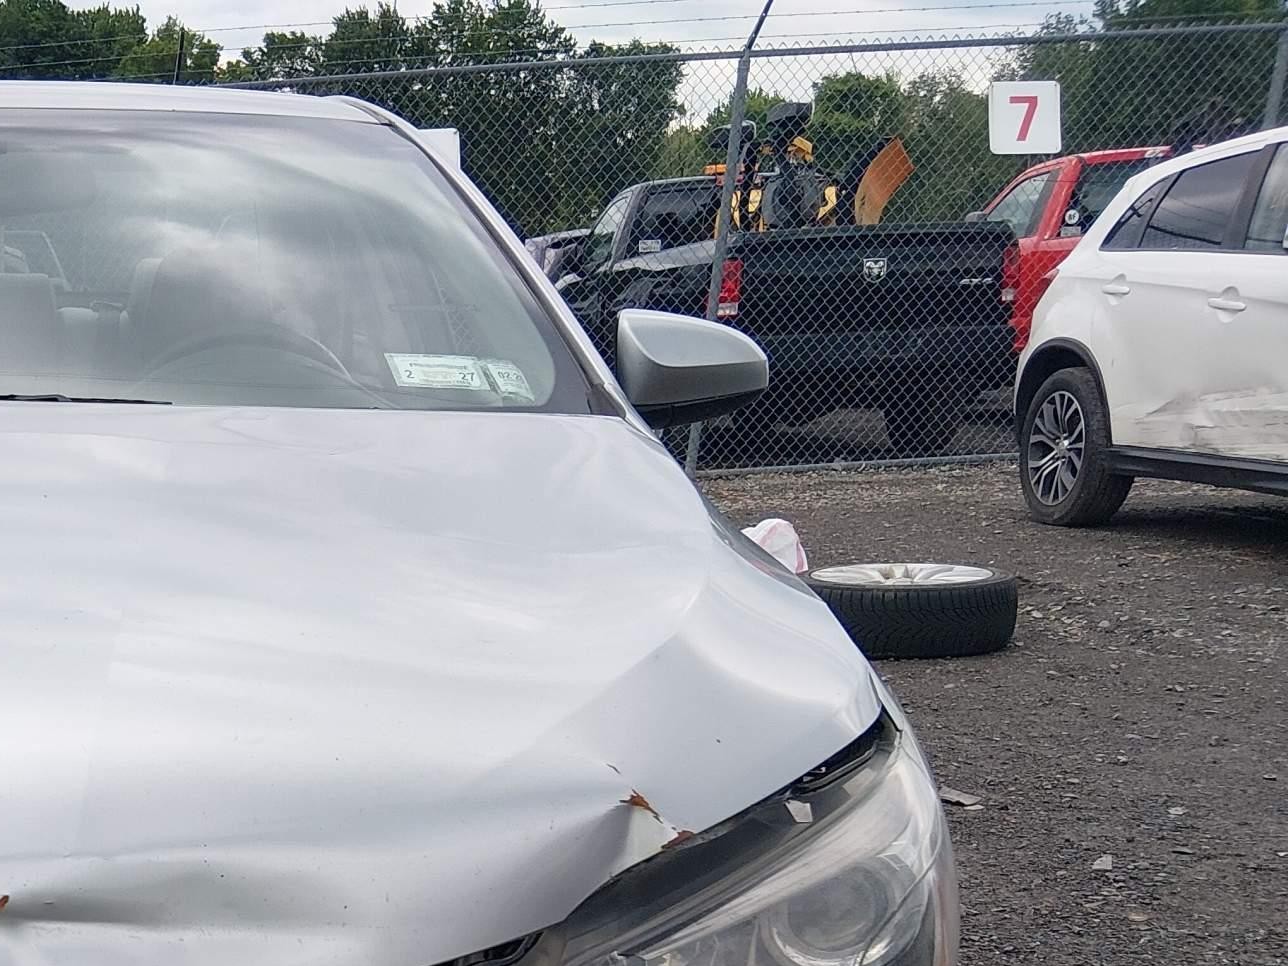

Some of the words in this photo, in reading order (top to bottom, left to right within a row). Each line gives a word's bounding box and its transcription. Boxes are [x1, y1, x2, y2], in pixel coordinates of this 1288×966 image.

[1009, 95, 1038, 142] 7
[404, 369, 415, 379] 2
[458, 372, 475, 382] 27
